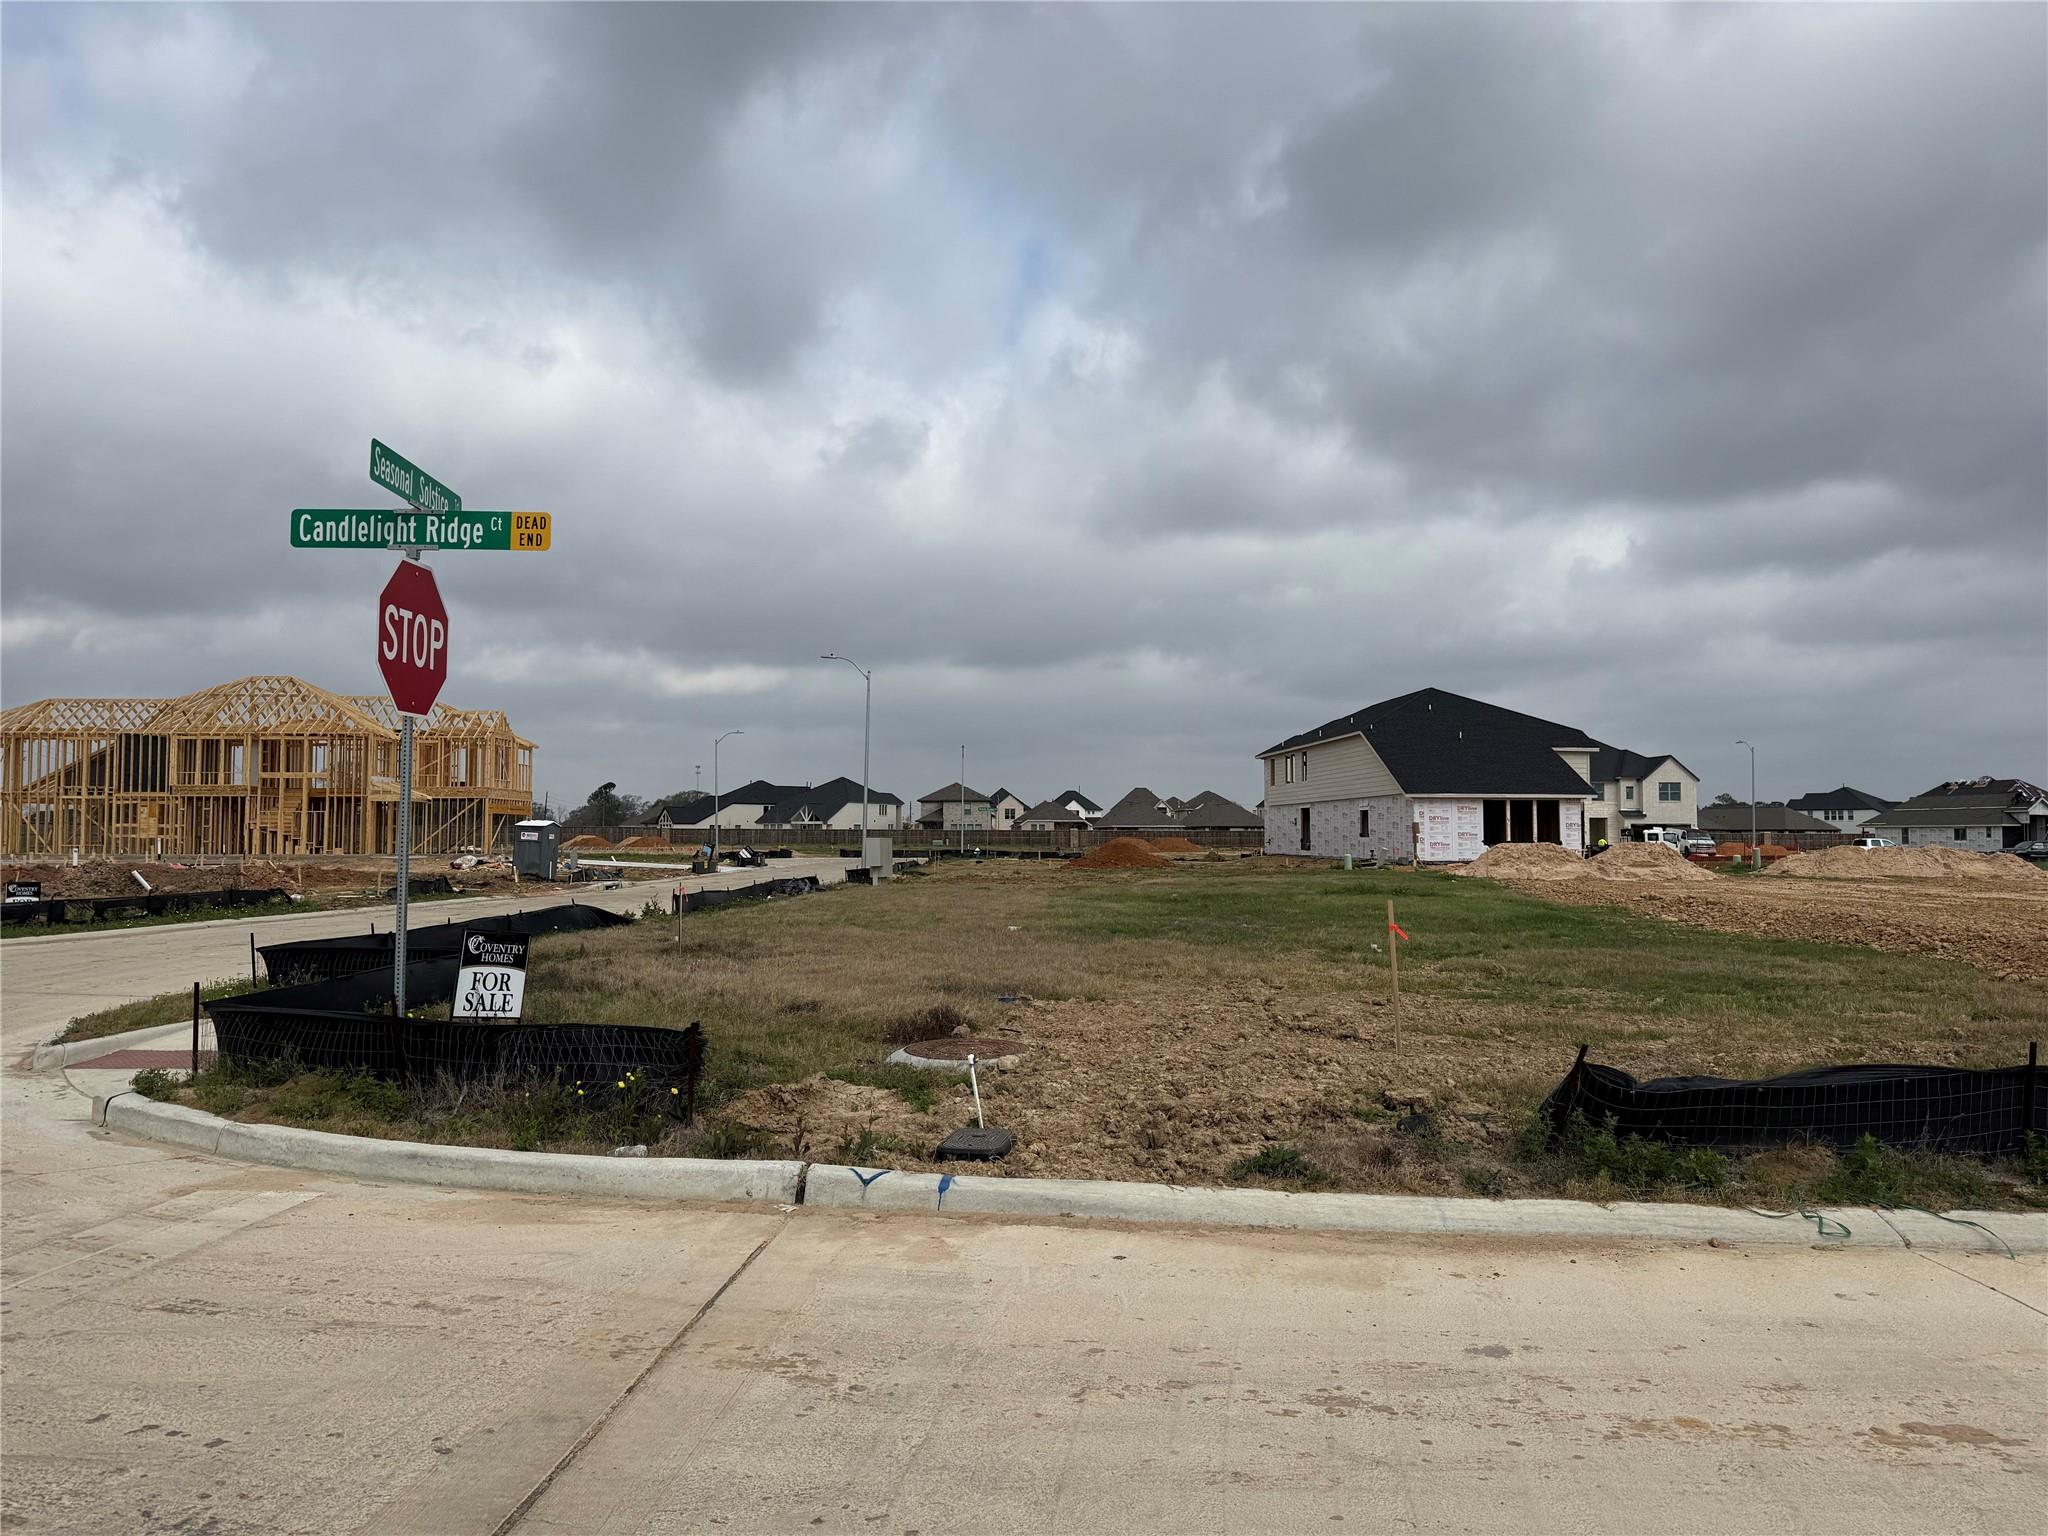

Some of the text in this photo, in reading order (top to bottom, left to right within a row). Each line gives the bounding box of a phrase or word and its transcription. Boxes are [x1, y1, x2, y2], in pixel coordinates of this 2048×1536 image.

[374, 446, 413, 496] Seasonal
[419, 476, 448, 511] Solstice
[299, 514, 502, 548] Candlelight Ridge Ct
[516, 516, 546, 530] DEAD
[520, 533, 542, 547] END
[383, 604, 444, 670] STOP
[467, 935, 525, 954] COVENTRY
[481, 953, 514, 963] HOMES
[470, 972, 511, 991] FOR
[463, 992, 513, 1012] SALE
